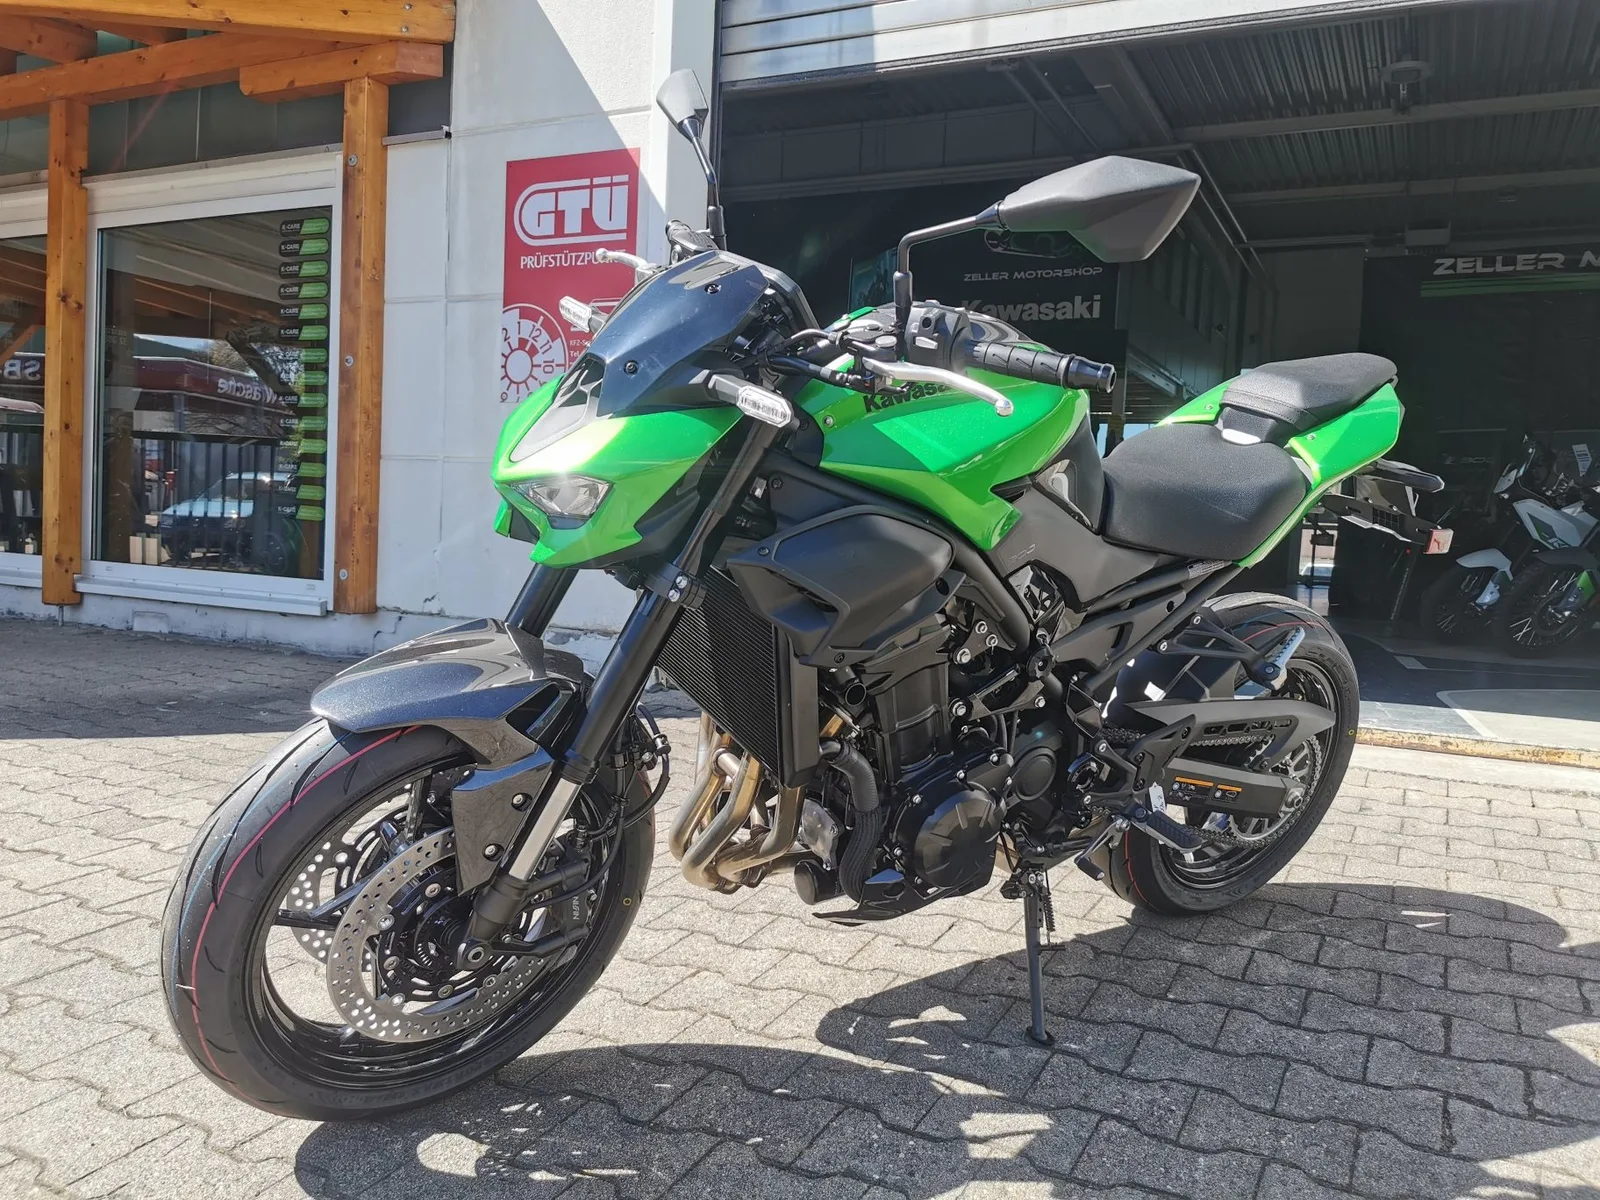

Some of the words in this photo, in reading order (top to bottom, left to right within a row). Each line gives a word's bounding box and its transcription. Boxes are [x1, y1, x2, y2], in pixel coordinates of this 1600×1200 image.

[520, 174, 630, 238] GTÜ
[1432, 252, 1566, 275] ZELLER
[963, 272, 1009, 282] ZELLER
[1012, 266, 1103, 280] MOTORSHOP
[528, 324, 543, 343] 12
[542, 358, 555, 375] 10
